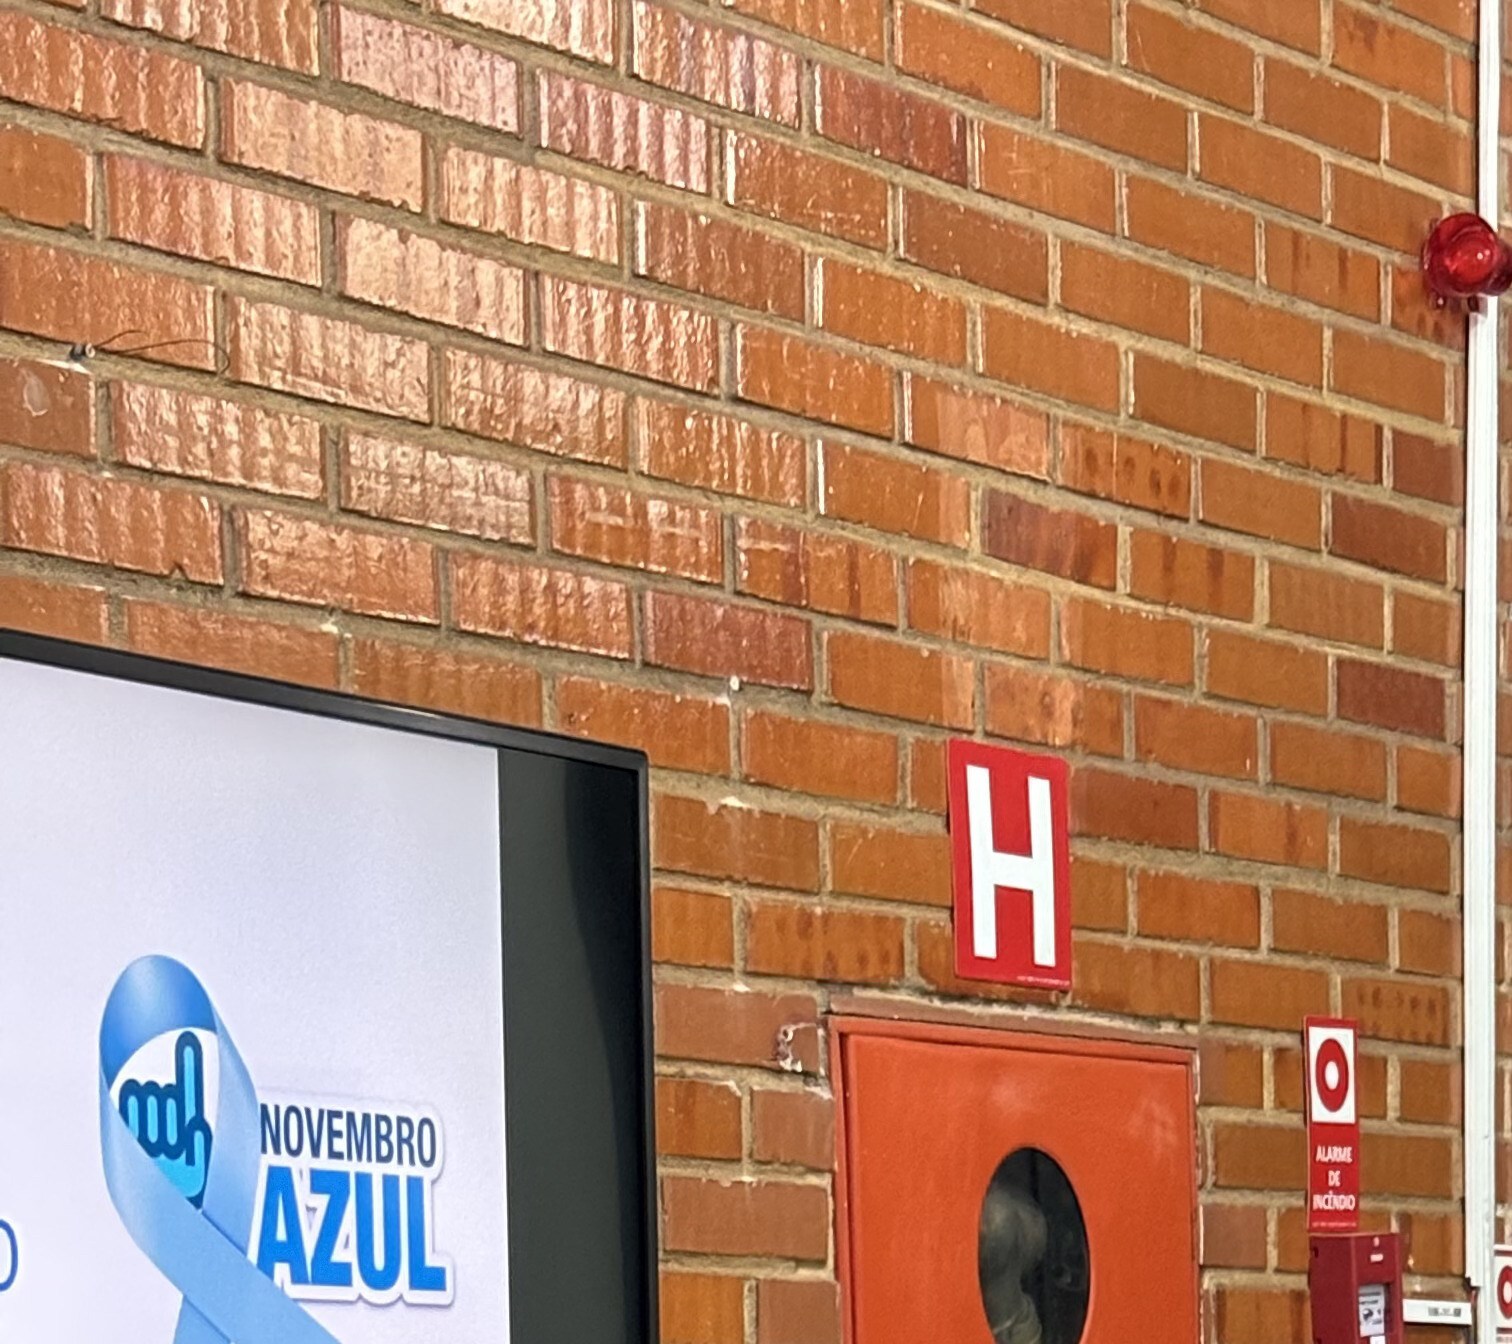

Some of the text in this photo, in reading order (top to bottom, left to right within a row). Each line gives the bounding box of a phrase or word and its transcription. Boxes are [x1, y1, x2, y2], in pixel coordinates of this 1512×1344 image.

[964, 763, 1057, 968] H
[260, 1103, 436, 1168] NOVEMBRO
[1315, 1145, 1353, 1164] ALARME
[1327, 1170, 1341, 1187] DE
[1312, 1190, 1356, 1211] INCÊNDIO
[257, 1165, 447, 1291] AZUL
